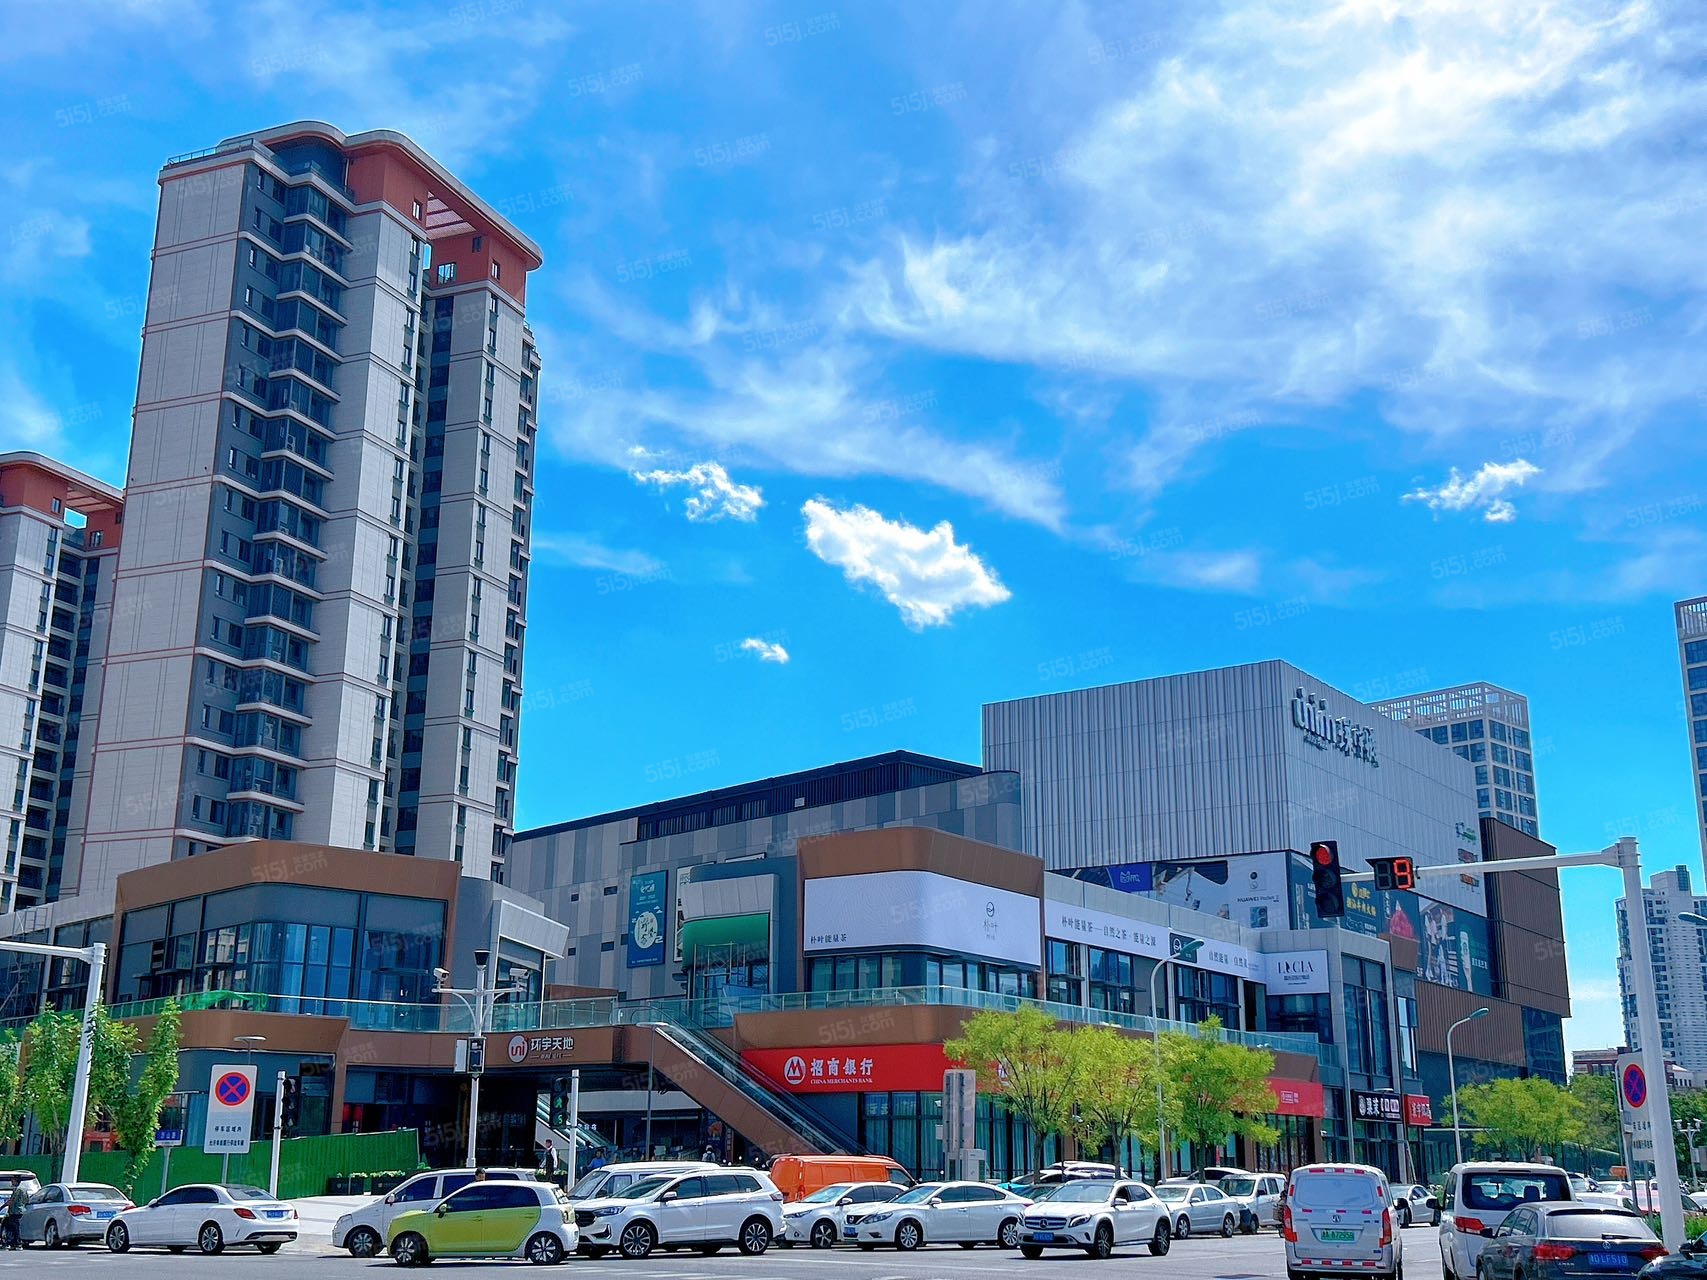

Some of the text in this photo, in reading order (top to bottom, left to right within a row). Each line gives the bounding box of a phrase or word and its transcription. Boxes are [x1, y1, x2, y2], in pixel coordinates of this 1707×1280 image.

[1393, 858, 1412, 890] 9
[530, 1036, 574, 1051] 环宇天地
[810, 1057, 874, 1077] 招商银行
